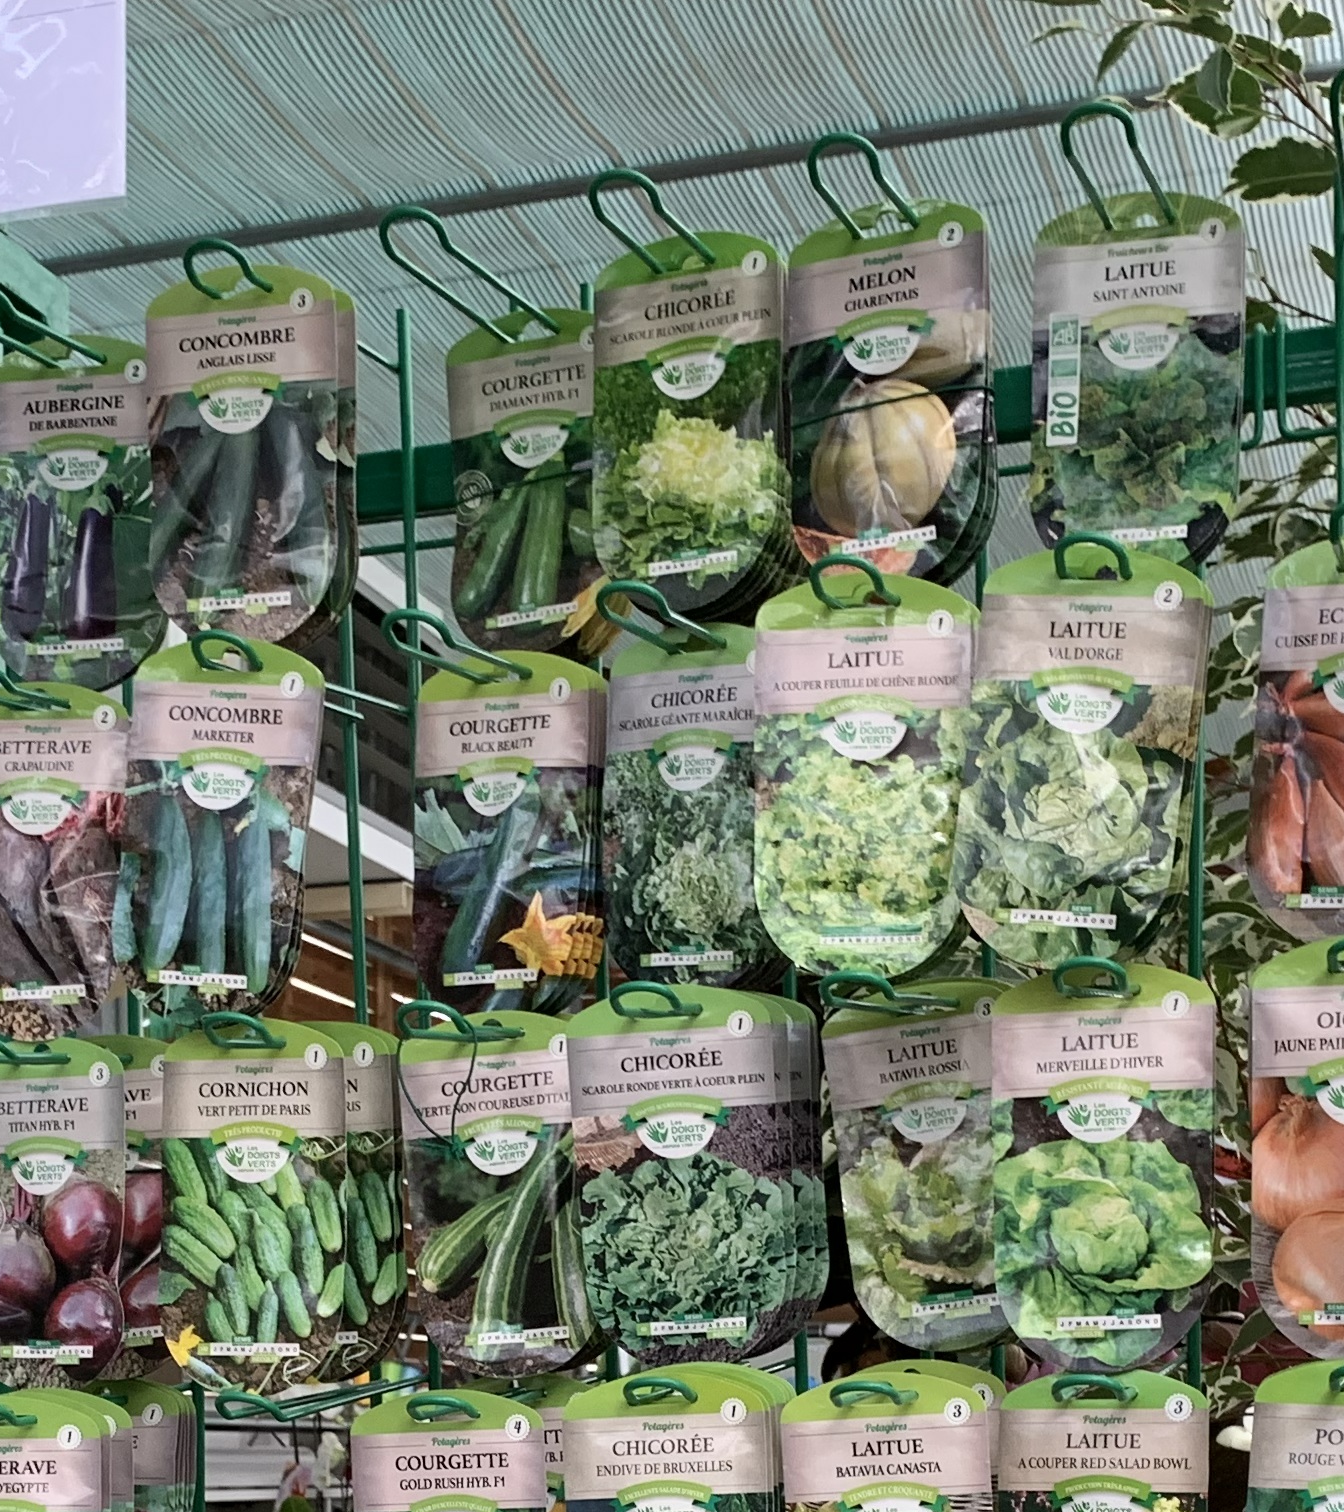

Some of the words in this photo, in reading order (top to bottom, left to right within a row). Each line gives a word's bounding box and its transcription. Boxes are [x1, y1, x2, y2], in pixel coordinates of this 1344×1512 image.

[849, 266, 915, 293] MELON
[1106, 261, 1176, 281] LAITUE
[645, 290, 734, 324] CHICORÉE
[845, 289, 918, 312] CHARENTAIS
[179, 328, 295, 352] CONCOMBRE
[198, 355, 244, 369] ANGLAIS
[247, 352, 275, 364] LISSE
[482, 364, 585, 400] COURGETTE
[23, 395, 124, 415] AUBERGINE
[29, 421, 44, 431] DE
[46, 416, 117, 430] BARBENTANE
[1050, 621, 1126, 639] LAITUE
[829, 651, 904, 668] LAITUE
[651, 684, 737, 708] CHICORÉE
[169, 706, 282, 725] CONCOMBRE
[450, 715, 550, 736] COURGETTE
[192, 729, 254, 743] MARKETER
[461, 742, 495, 754] BLACK
[498, 737, 533, 752] BEAUTY
[5, 761, 73, 772] CRAPAUDINE
[887, 1039, 957, 1063] LAITUE
[1062, 1033, 1138, 1051] LAITUE
[621, 1051, 722, 1072] CHICORÉE
[1037, 1059, 1106, 1073] MERVEILLE
[1111, 1056, 1163, 1069] D'HIVER
[199, 1082, 308, 1097] CORNICHON
[442, 1071, 547, 1097] COURGETTE
[198, 1106, 226, 1116] VERT
[226, 1105, 260, 1116] PETIT
[262, 1105, 276, 1115] DE
[277, 1104, 310, 1115] PARIS
[953, 1405, 961, 1417] 3
[613, 1434, 713, 1456] CHICORÉE
[852, 1439, 923, 1456] LAITUE
[1066, 1434, 1140, 1448] LAITUE
[396, 1453, 508, 1471] COURGETTE
[836, 1465, 884, 1477] BATAVIA
[887, 1462, 941, 1475] CANASTA
